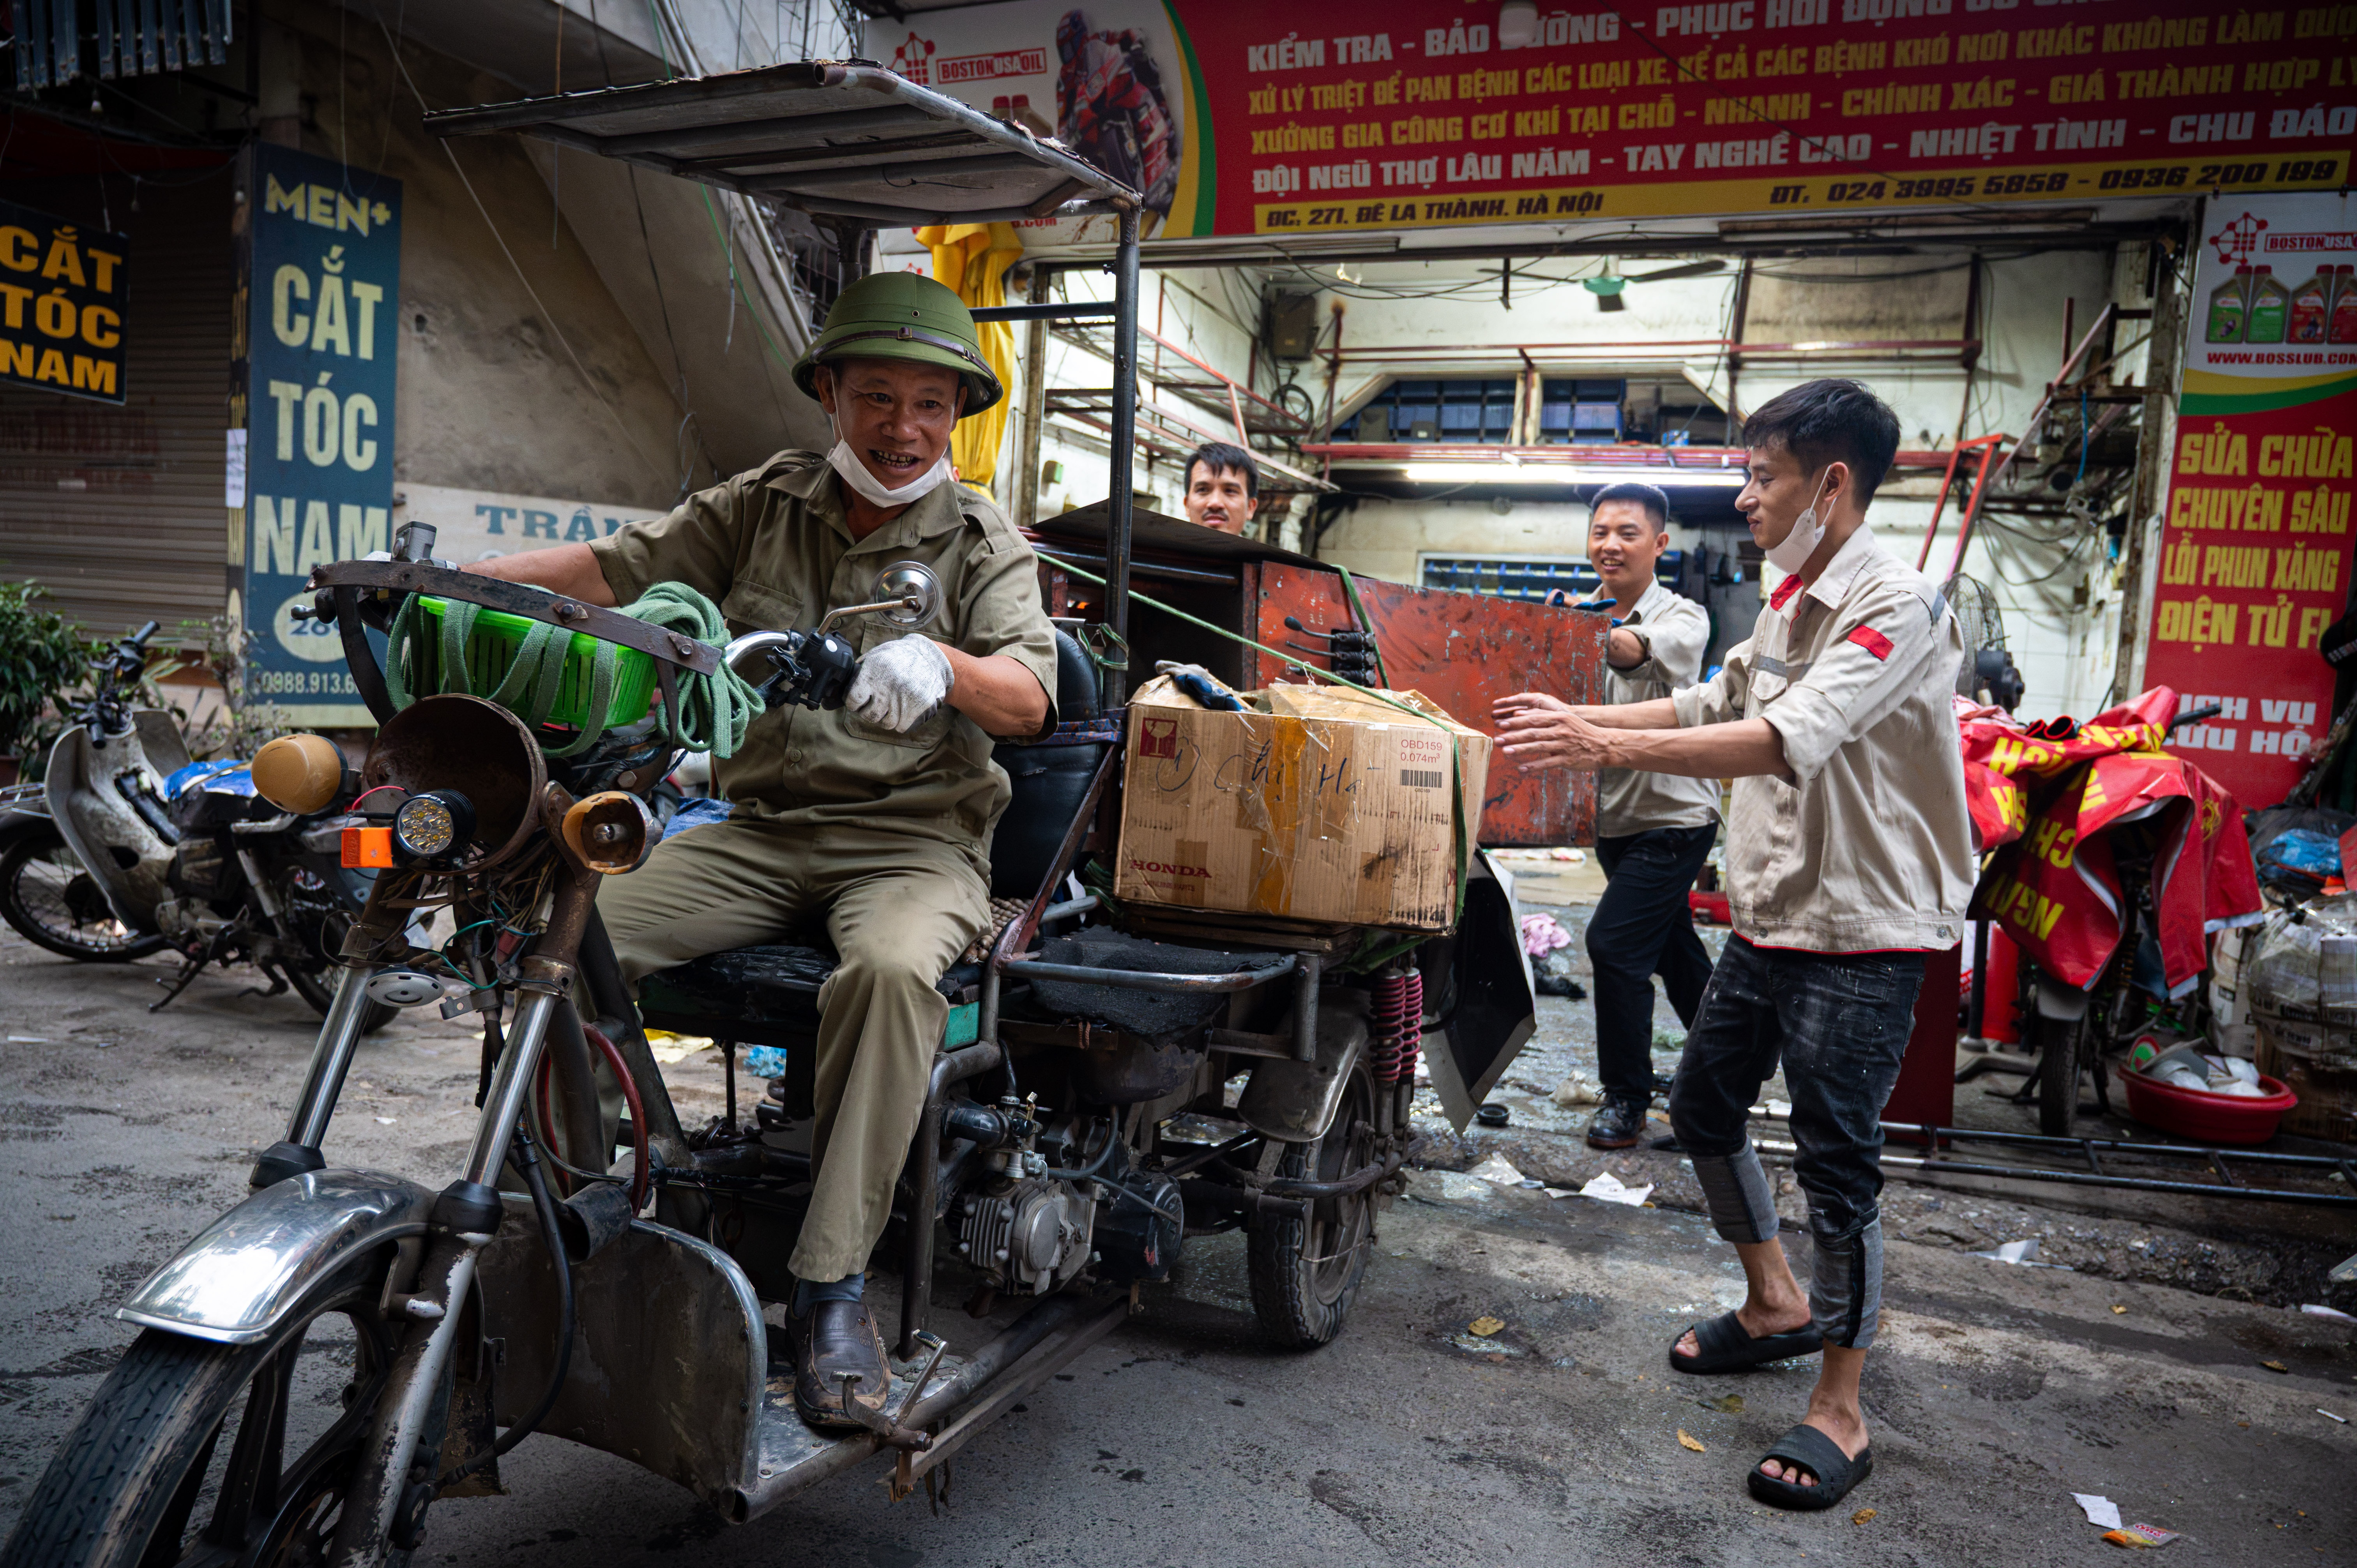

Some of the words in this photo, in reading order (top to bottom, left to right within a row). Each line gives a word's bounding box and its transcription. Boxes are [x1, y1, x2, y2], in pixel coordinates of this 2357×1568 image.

[1248, 32, 1325, 72] KIỂM
[1333, 34, 1393, 65] TRA
[1424, 18, 1489, 57] BẢO
[1656, 1, 1754, 39] PHỤC
[1249, 82, 1277, 115] XỬ
[1282, 83, 1305, 112] LÝ
[1311, 79, 1366, 113] TRIỆT
[1373, 70, 1403, 106] ĐỂ
[1406, 75, 1451, 103] PAN
[1458, 67, 1519, 104] BỆNH
[1526, 62, 1572, 94] CÁC
[1578, 60, 1631, 94] LOẠI
[1677, 44, 1712, 82] KỂ
[1715, 43, 1749, 80] CẢ
[1756, 43, 1809, 78] CÁC
[1814, 38, 1887, 79] BỆNH
[1893, 30, 1949, 68] KHÓ
[1956, 28, 2010, 64] NƠI
[2016, 21, 2096, 59] KHÁC
[2102, 15, 2209, 53] KHÔNG
[2216, 8, 2285, 45] LÀM
[1251, 120, 1335, 154] XƯỞNG
[1343, 122, 1384, 149] GIA
[1391, 115, 1463, 146] CÔNG
[1471, 110, 1508, 140] CƠ
[1514, 104, 1560, 137] KHÍ
[1567, 105, 1610, 138] TẠI
[1618, 93, 1676, 130] CHỖ
[1704, 92, 1811, 125] NHANH
[1841, 81, 1942, 117] CHÍNH
[1949, 75, 2016, 111] XÁC
[2048, 67, 2105, 104] GIÁ
[2117, 62, 2235, 100] THÀNH
[2243, 56, 2320, 97] HỢP
[1251, 164, 1300, 197] ĐỘI
[1309, 159, 1371, 190] NGŨ
[1379, 155, 1439, 190] THỢ
[1446, 152, 1502, 182] LÂU
[1511, 147, 1590, 179] NĂM
[1623, 143, 1686, 172] TAY
[1694, 130, 1791, 169] NGHỀ
[1799, 133, 1872, 164] CAO
[1909, 120, 2023, 161] NHIỆT
[2031, 117, 2127, 151] TÌNH
[2168, 111, 2256, 143] CHU
[2269, 102, 2357, 139] ĐÁO
[1390, 203, 1417, 222] LA
[1516, 193, 1548, 215] HÀ
[1556, 191, 1605, 217] NỘI
[1827, 181, 1887, 202] 024
[1982, 172, 2070, 194] 5858
[2099, 167, 2190, 190] 0936
[2196, 162, 2269, 185] 200
[2275, 160, 2338, 182] 199
[0, 226, 122, 295] CẮT
[0, 283, 121, 349] TÓC
[272, 245, 383, 361] CẮT
[0, 338, 118, 395] NAM
[269, 371, 379, 472] TÓC
[2178, 421, 2248, 476] SỬA
[2258, 426, 2353, 479] CHỮA
[253, 494, 389, 576] NAM
[2170, 482, 2285, 531] CHUYÊN
[2289, 484, 2352, 534] SÂU
[2163, 531, 2200, 584] LỖI
[2203, 546, 2270, 589] PHUN
[2272, 541, 2341, 592] XĂNG
[2157, 594, 2238, 653] ĐIỆN
[2247, 593, 2294, 648] TỬ
[2261, 699, 2316, 729] VỤ
[1401, 739, 1442, 751] OBD159
[2250, 729, 2311, 761] HỘ
[1130, 860, 1212, 878] HONDA
